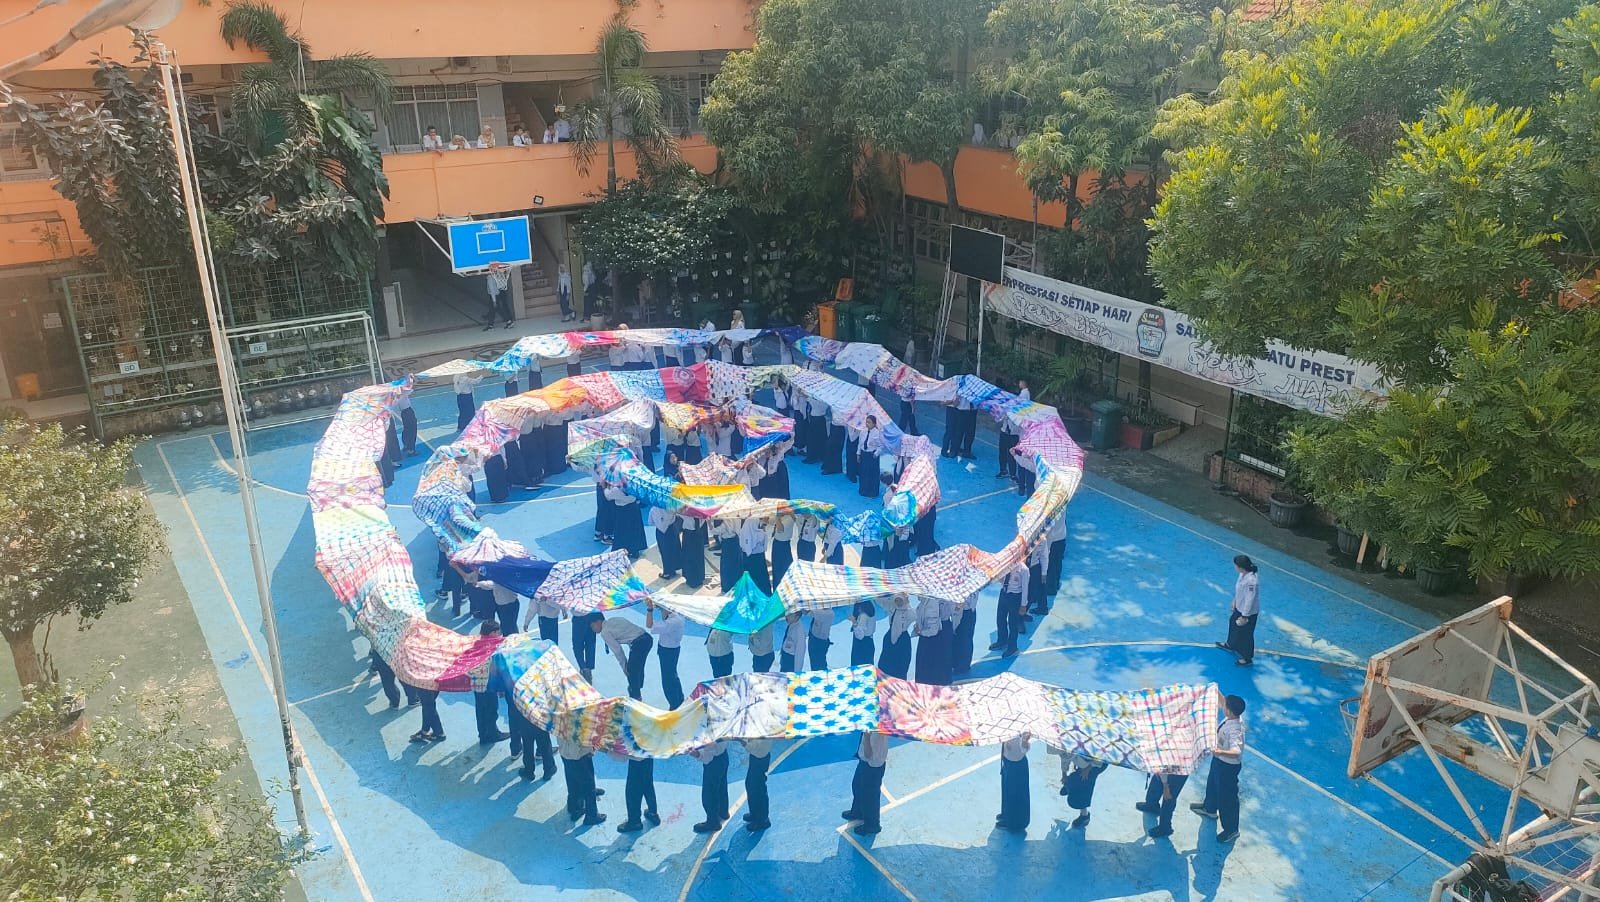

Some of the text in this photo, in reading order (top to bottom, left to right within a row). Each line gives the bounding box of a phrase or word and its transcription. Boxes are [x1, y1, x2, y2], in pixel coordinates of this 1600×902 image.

[1060, 294, 1100, 314] SETIAP
[1103, 306, 1132, 323] HARI
[1261, 349, 1297, 369] ATU
[1301, 358, 1355, 385] PREST
